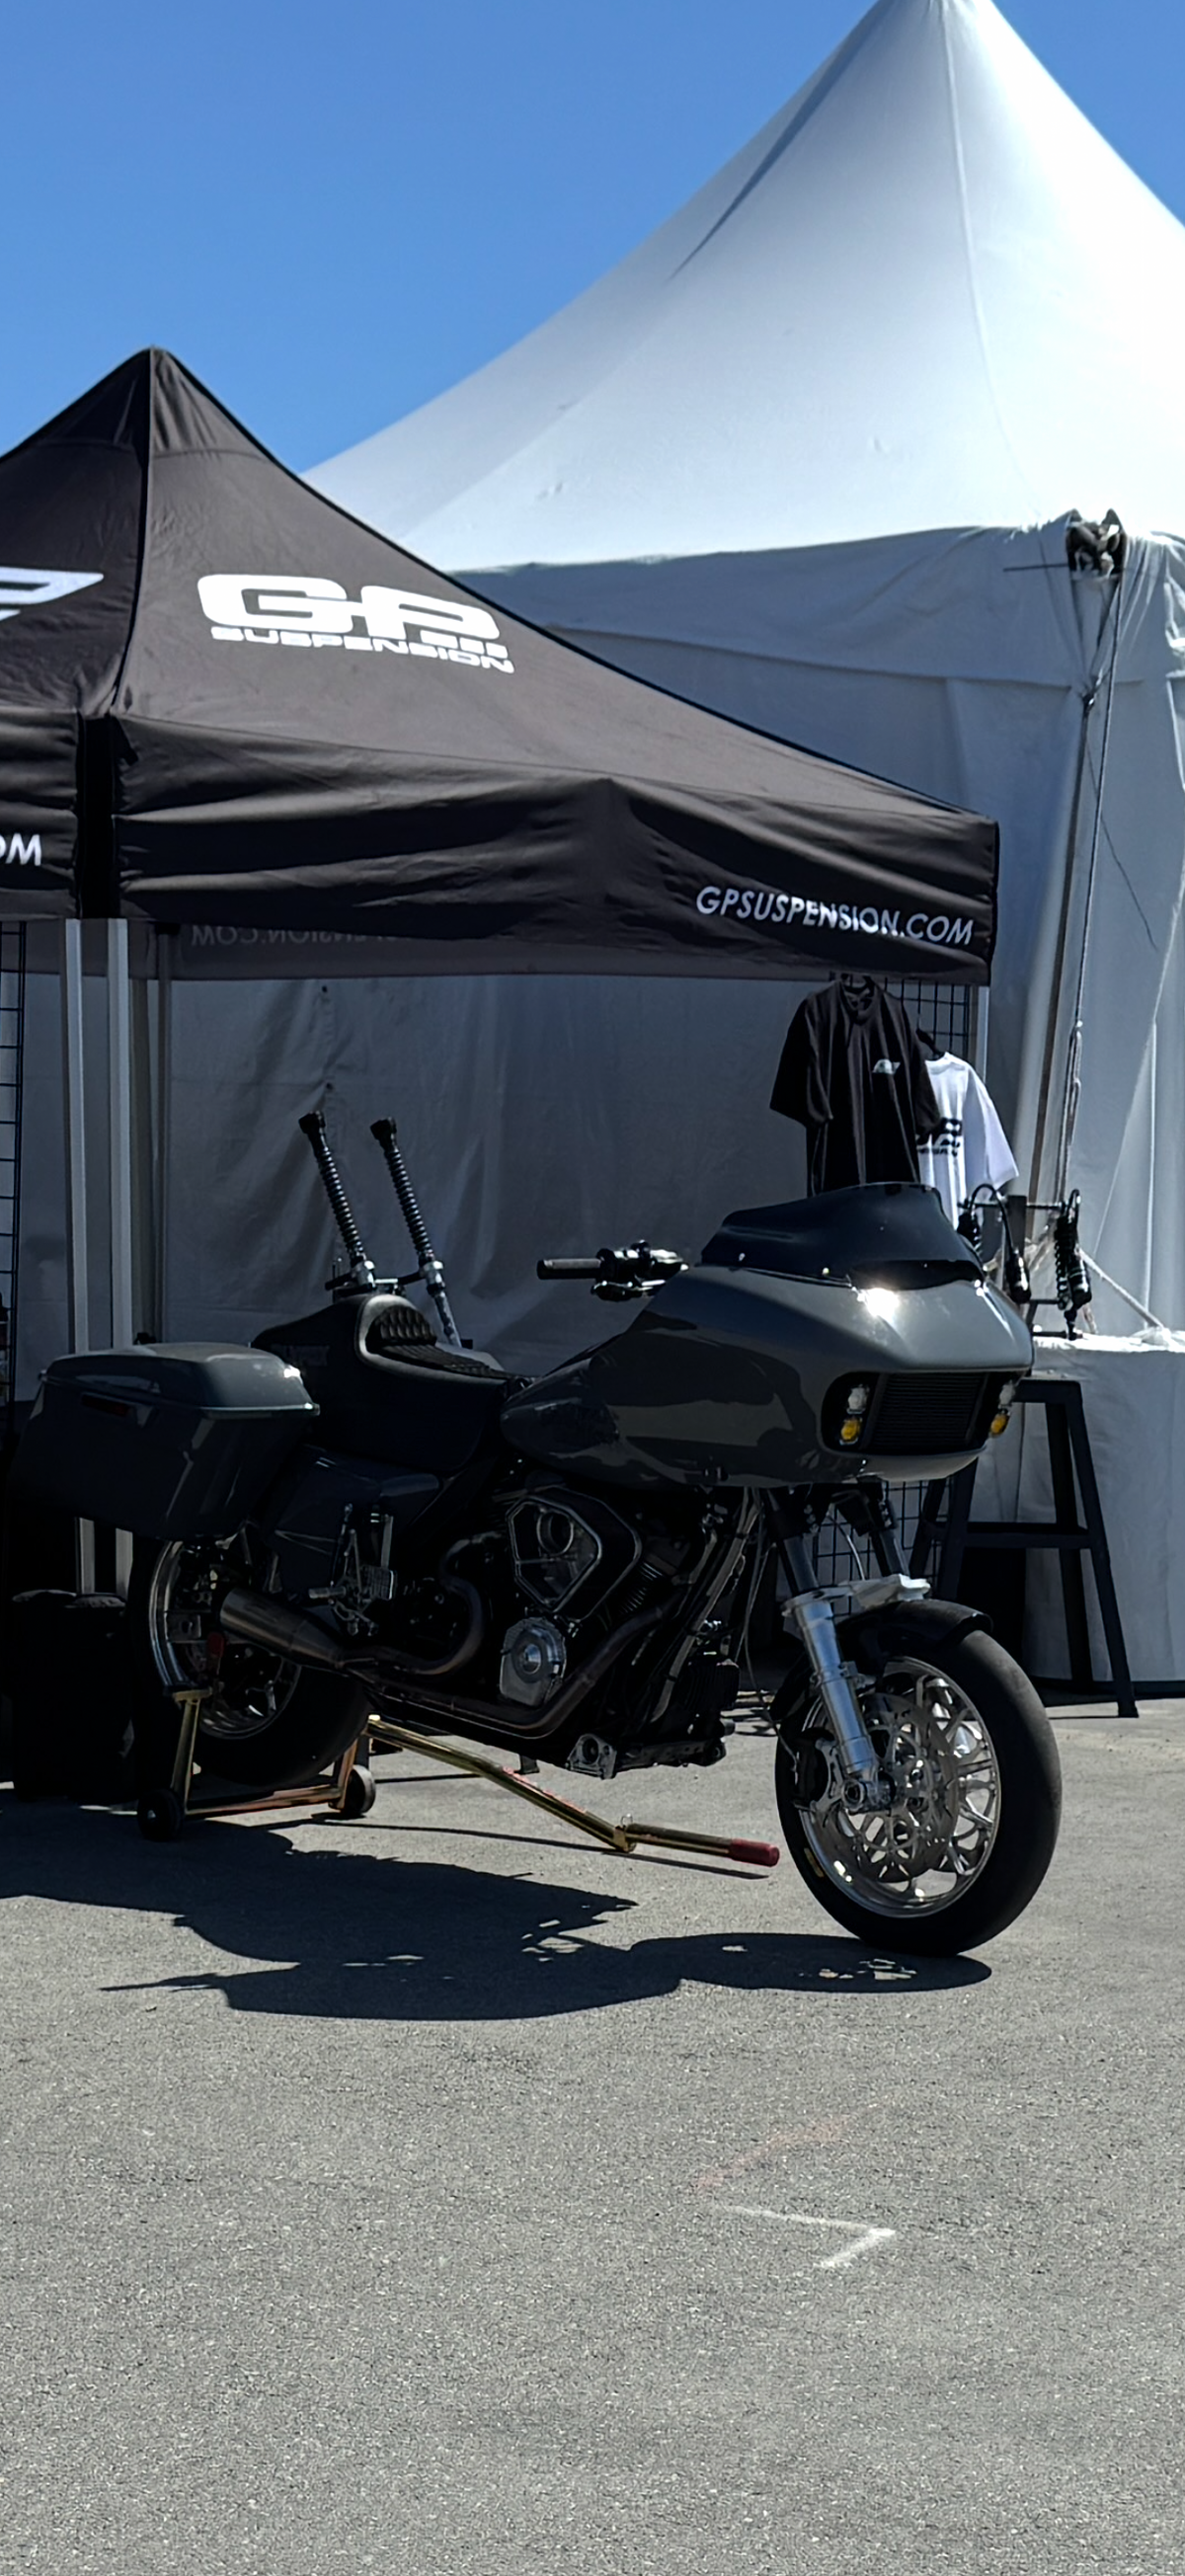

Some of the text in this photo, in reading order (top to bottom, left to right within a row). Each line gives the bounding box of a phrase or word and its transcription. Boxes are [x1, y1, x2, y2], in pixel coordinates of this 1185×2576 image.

[210, 626, 514, 673] SUSPENSION
[0, 832, 41, 866] M
[696, 886, 974, 945] GPSUSPENSION.COM
